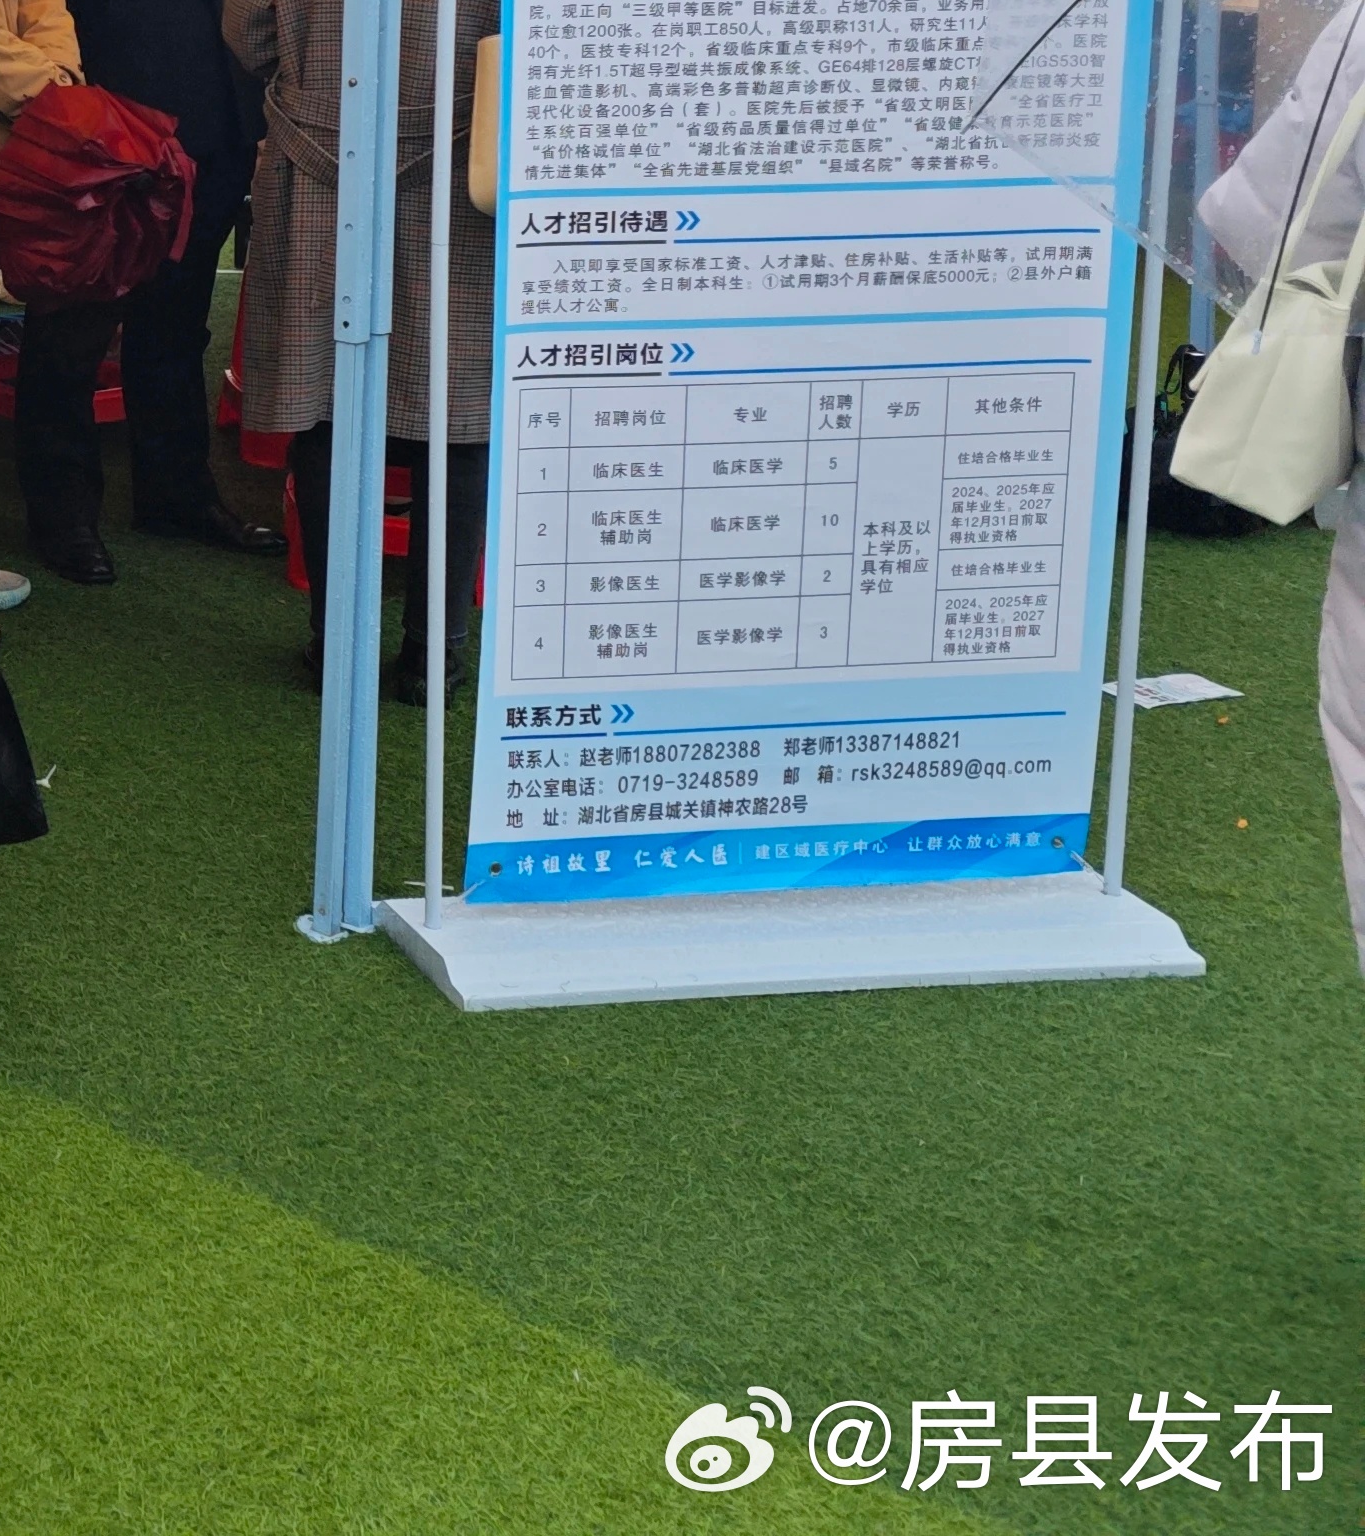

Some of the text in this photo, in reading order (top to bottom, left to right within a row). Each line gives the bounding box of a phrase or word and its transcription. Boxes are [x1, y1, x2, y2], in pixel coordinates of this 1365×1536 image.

[521, 210, 668, 235] 人才招引待遇
[521, 298, 628, 315] 提供人才公寓。
[518, 343, 664, 368] 人才招引岗位
[819, 394, 853, 411] 招聘
[887, 401, 921, 418] 学历
[974, 396, 1042, 415] 其他条件
[527, 412, 561, 429] 序号
[594, 409, 666, 427] 招聘岗位
[733, 407, 767, 424] 专业
[818, 414, 852, 431] 人数
[829, 457, 837, 470] 5
[957, 449, 1054, 465] 住培合格毕业生
[540, 467, 547, 480] 1
[593, 462, 664, 479] 临床医生
[713, 458, 783, 476] 临床医学
[951, 482, 1055, 498] 2024、2025年应
[591, 509, 662, 527] 临床医生
[710, 515, 780, 533] 临床医学
[821, 514, 839, 527] 10
[950, 513, 1048, 529] 年12月31日前取
[537, 523, 547, 537] 2
[863, 519, 931, 537] 本科及以
[600, 528, 652, 546] 辅助岗
[949, 529, 1018, 545] 得执业资格
[860, 558, 930, 576] 具有相应
[951, 562, 1047, 577] 住培合格毕业生
[589, 575, 660, 593] 影像医生
[699, 570, 786, 590] 医学影像学
[823, 570, 831, 583] 2
[536, 579, 546, 593] 3
[860, 577, 894, 595] 学位
[945, 595, 1048, 611] 2024、2025年应
[588, 623, 658, 640] 影像医生
[697, 626, 783, 646] 医学影像学
[820, 626, 828, 639] 3
[944, 624, 1041, 640] 年12月31日前取
[534, 636, 544, 650] 4
[596, 642, 648, 659] 辅助岗
[943, 641, 1011, 656] 得执业资格
[506, 704, 602, 729] 联系方式
[508, 731, 960, 770] 联系人：赵老师18807282388 郑老师13387148821
[517, 831, 1043, 876] 诗祖故里 仁爱人医 建区域医疗中心 让群众放心满意
